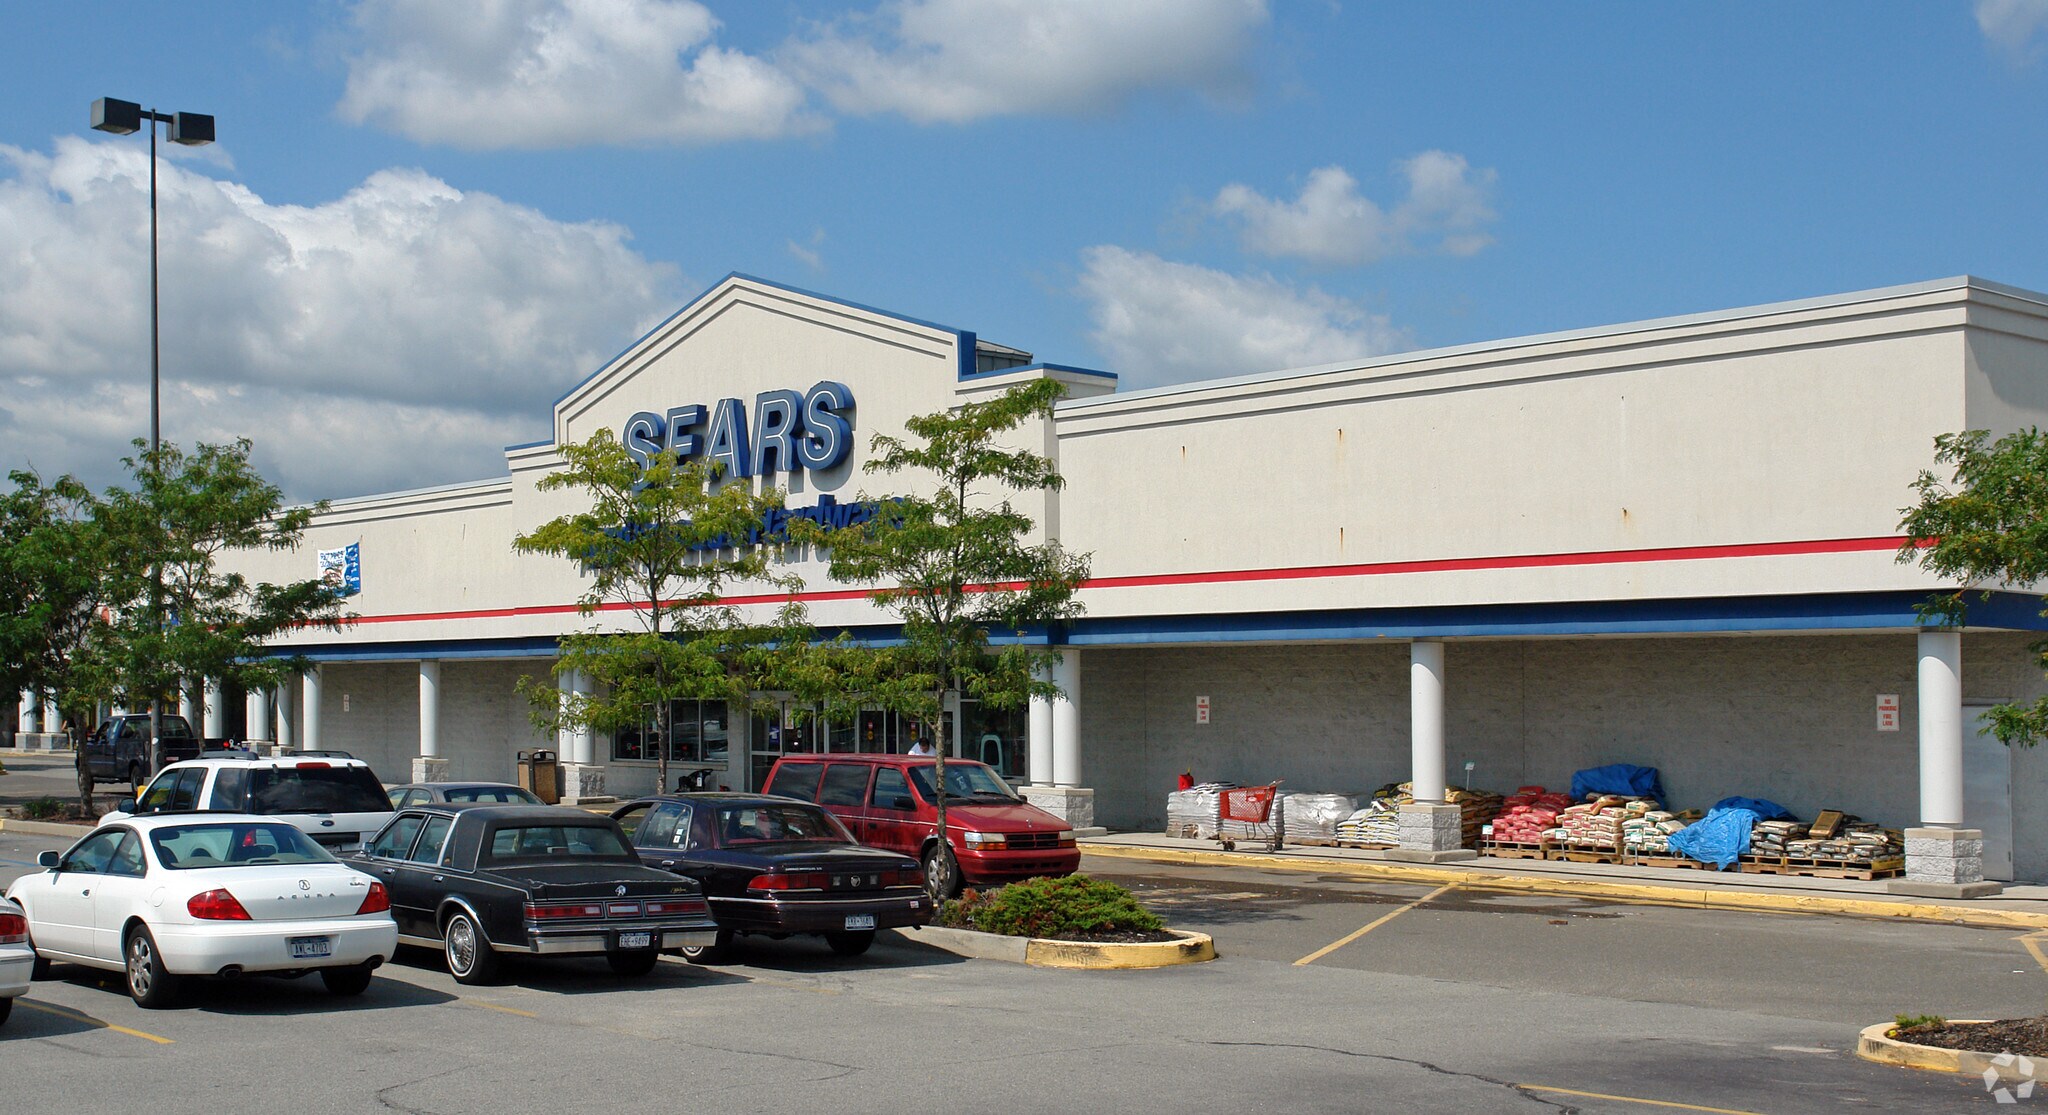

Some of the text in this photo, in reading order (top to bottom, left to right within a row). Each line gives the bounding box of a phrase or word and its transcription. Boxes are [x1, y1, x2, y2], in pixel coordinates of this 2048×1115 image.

[623, 381, 855, 491] SEARS
[748, 494, 907, 544] Hardwa
[277, 892, 336, 900] ACURA
